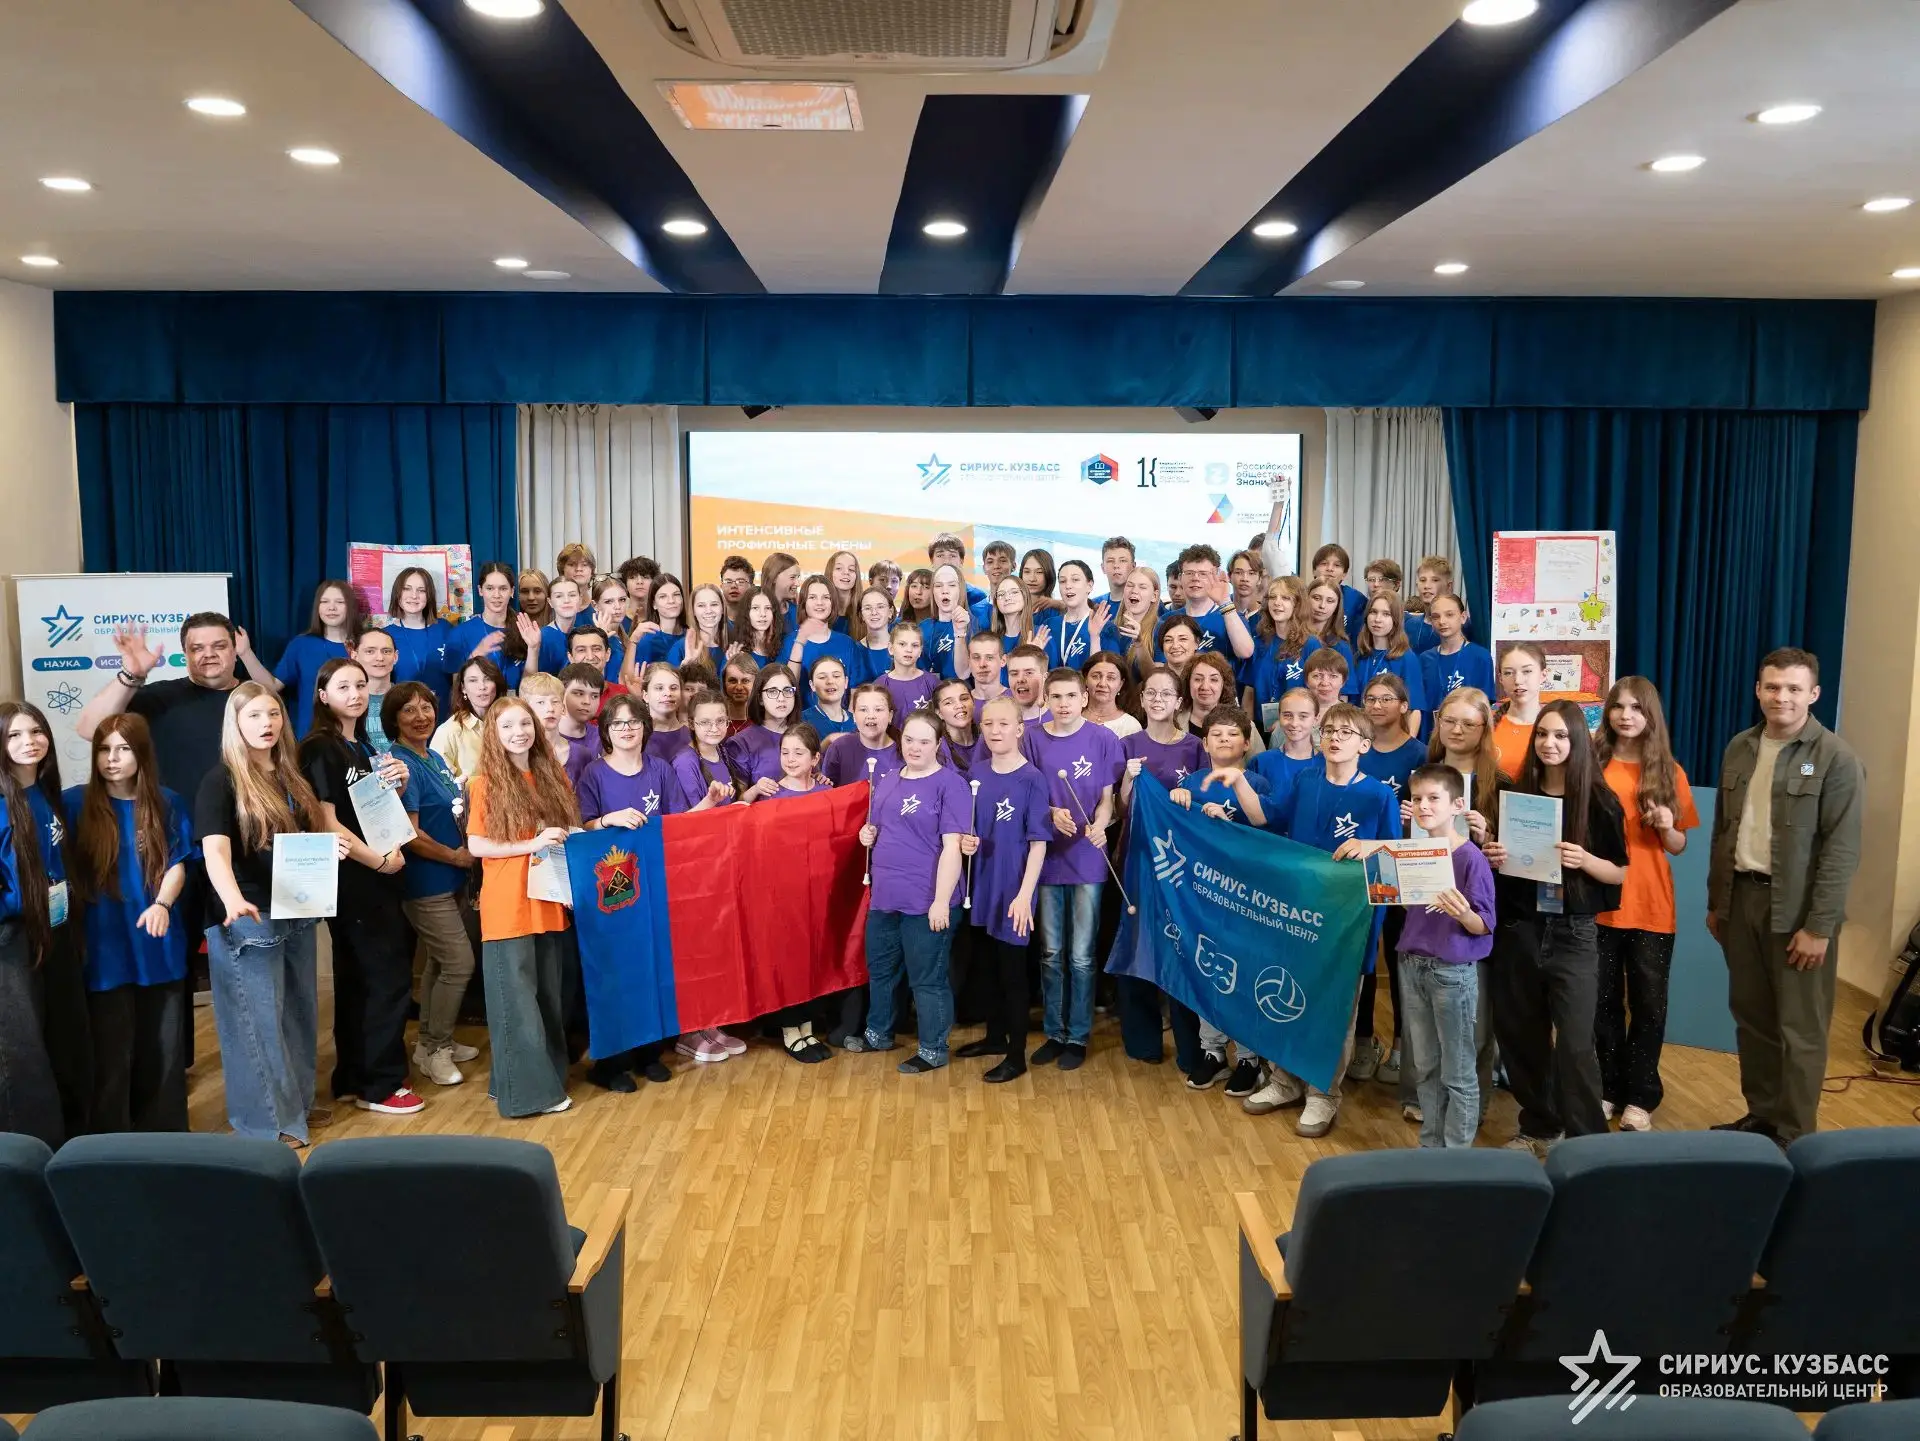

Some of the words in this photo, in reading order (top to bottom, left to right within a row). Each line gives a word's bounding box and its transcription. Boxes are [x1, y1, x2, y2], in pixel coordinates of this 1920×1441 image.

[960, 463, 1008, 471] СИРИУС.
[1010, 463, 1060, 471] КУЗБАСС
[1236, 462, 1294, 471] Российское
[1236, 478, 1267, 486] Знани
[717, 525, 825, 535] ИНТЕНСИВНЫЕ
[717, 540, 816, 550] ПРОФИЛЬНЫЕ
[820, 540, 872, 550] СМЕНЫ
[43, 659, 81, 668] НАУКА
[1193, 861, 1249, 901] СИРИУС.
[1251, 889, 1324, 927] КУЗБАСС
[1193, 881, 1284, 931] ОБРАЗОВАТЕЛЬНЫЙ
[1285, 923, 1319, 944] ЦЕНТР
